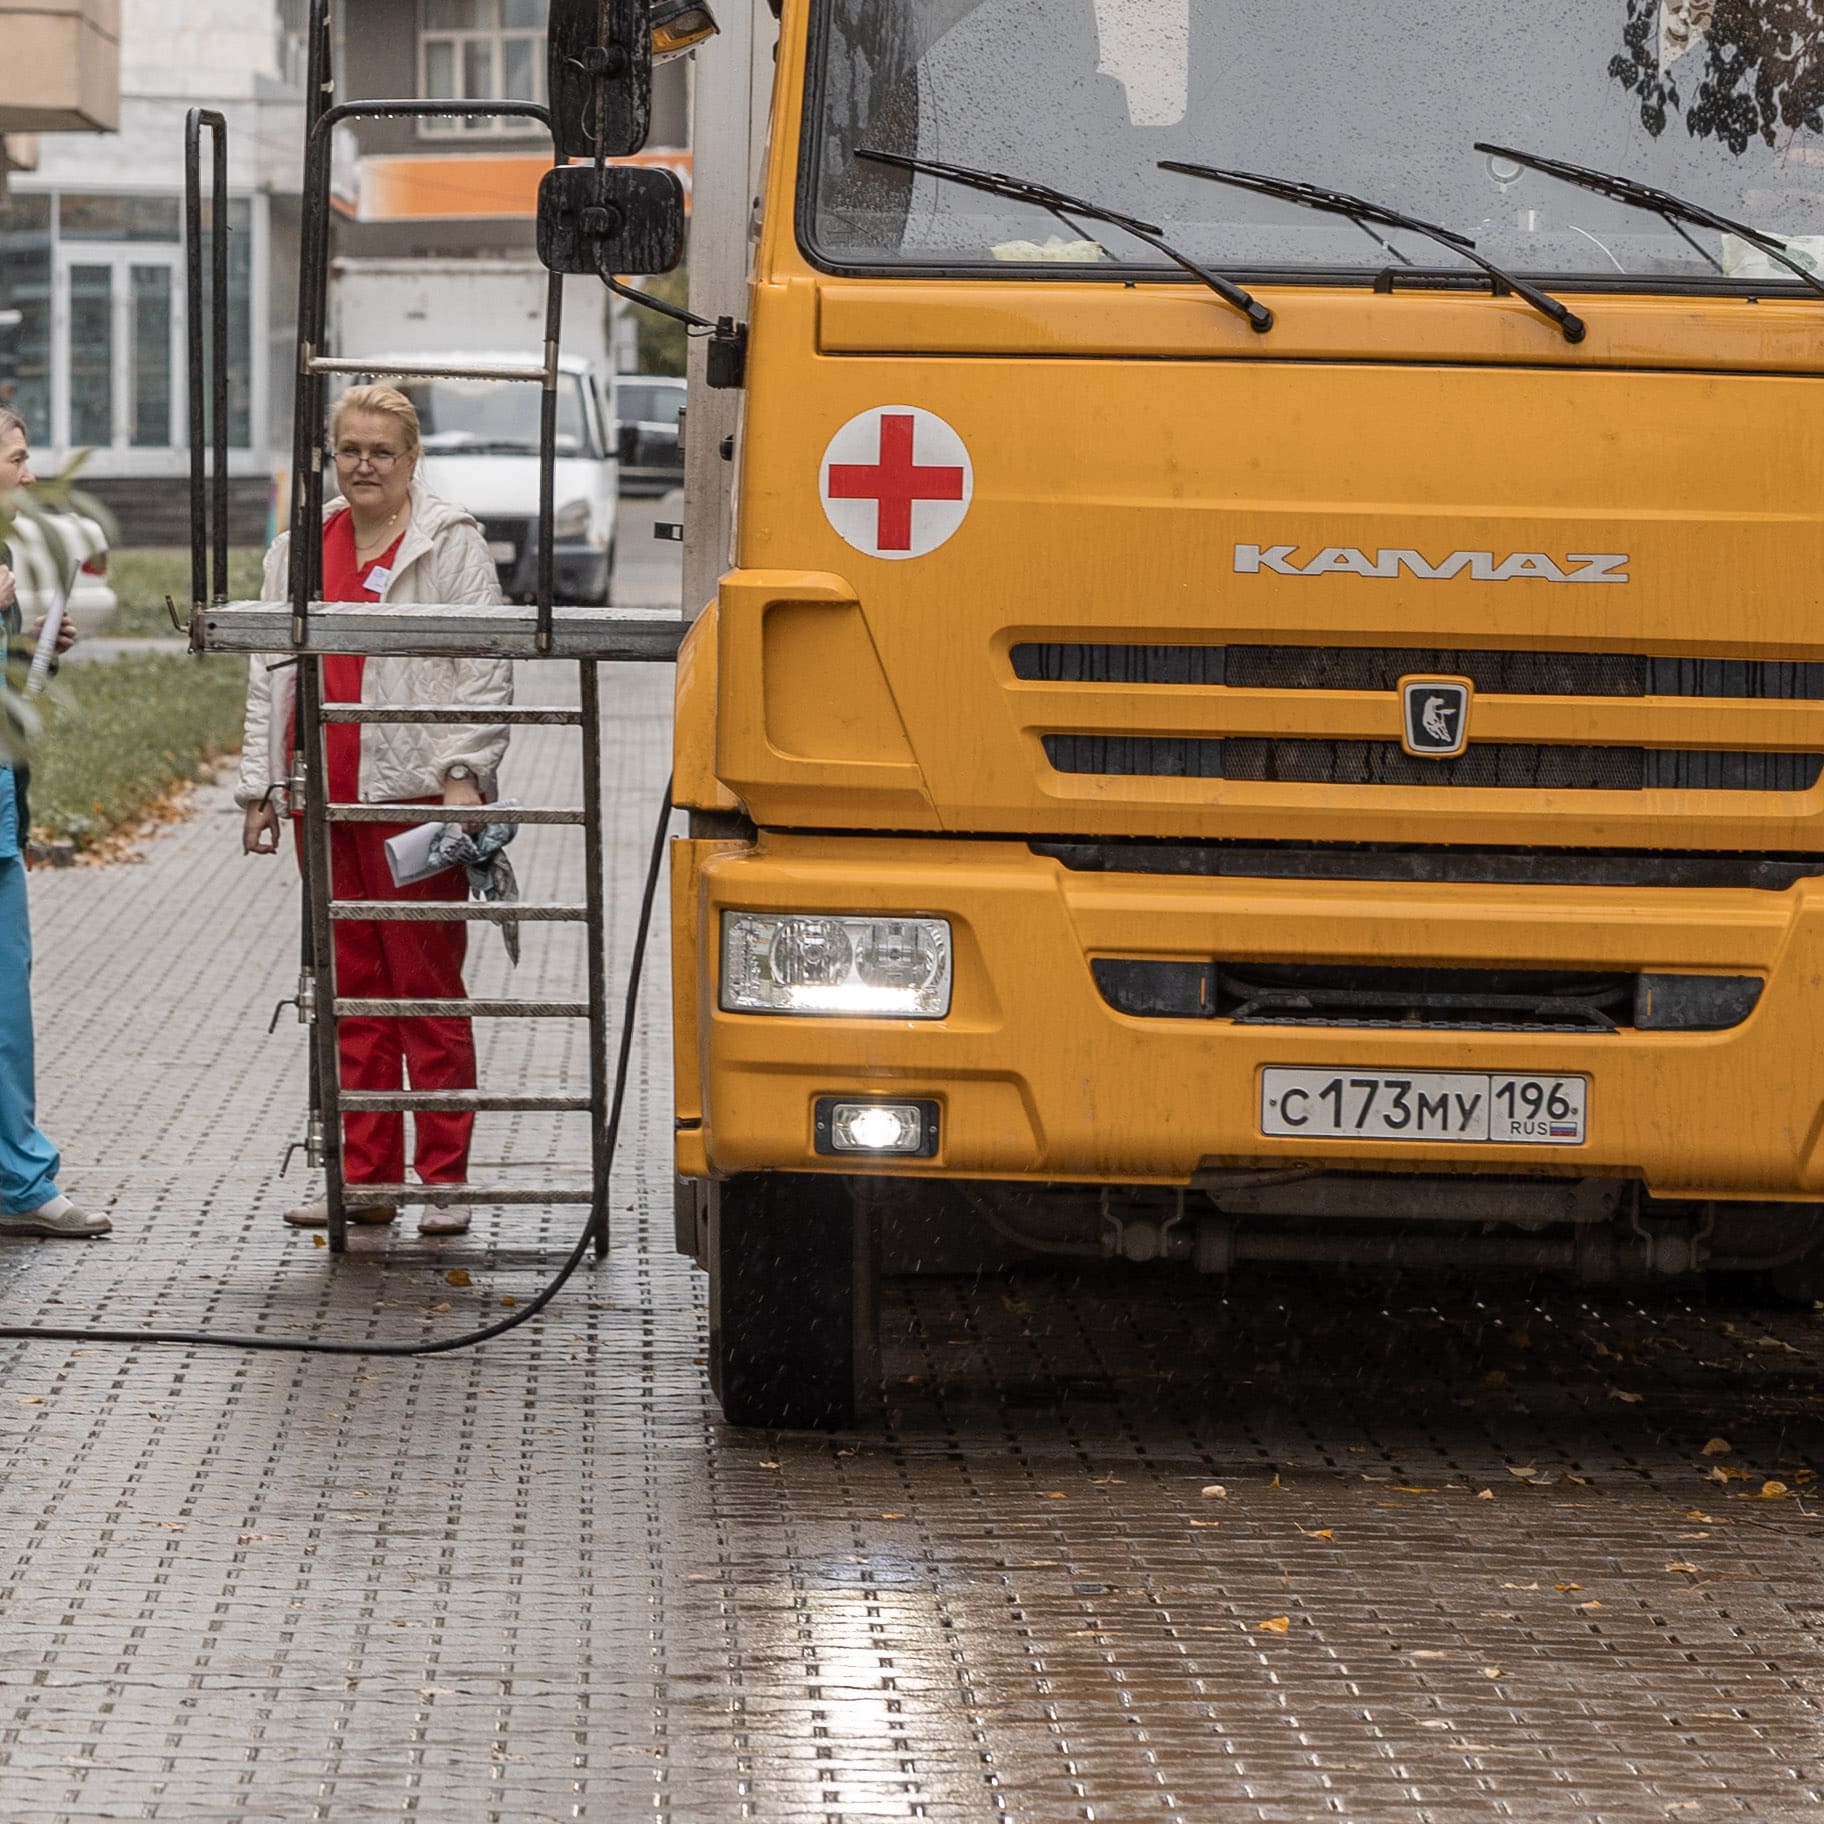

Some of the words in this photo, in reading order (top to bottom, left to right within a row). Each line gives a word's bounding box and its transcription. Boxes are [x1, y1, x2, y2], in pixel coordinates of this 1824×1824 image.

[1233, 543, 1629, 583] KAMAZ
[1495, 1081, 1570, 1120] 196
[1510, 1121, 1549, 1136] RUS
